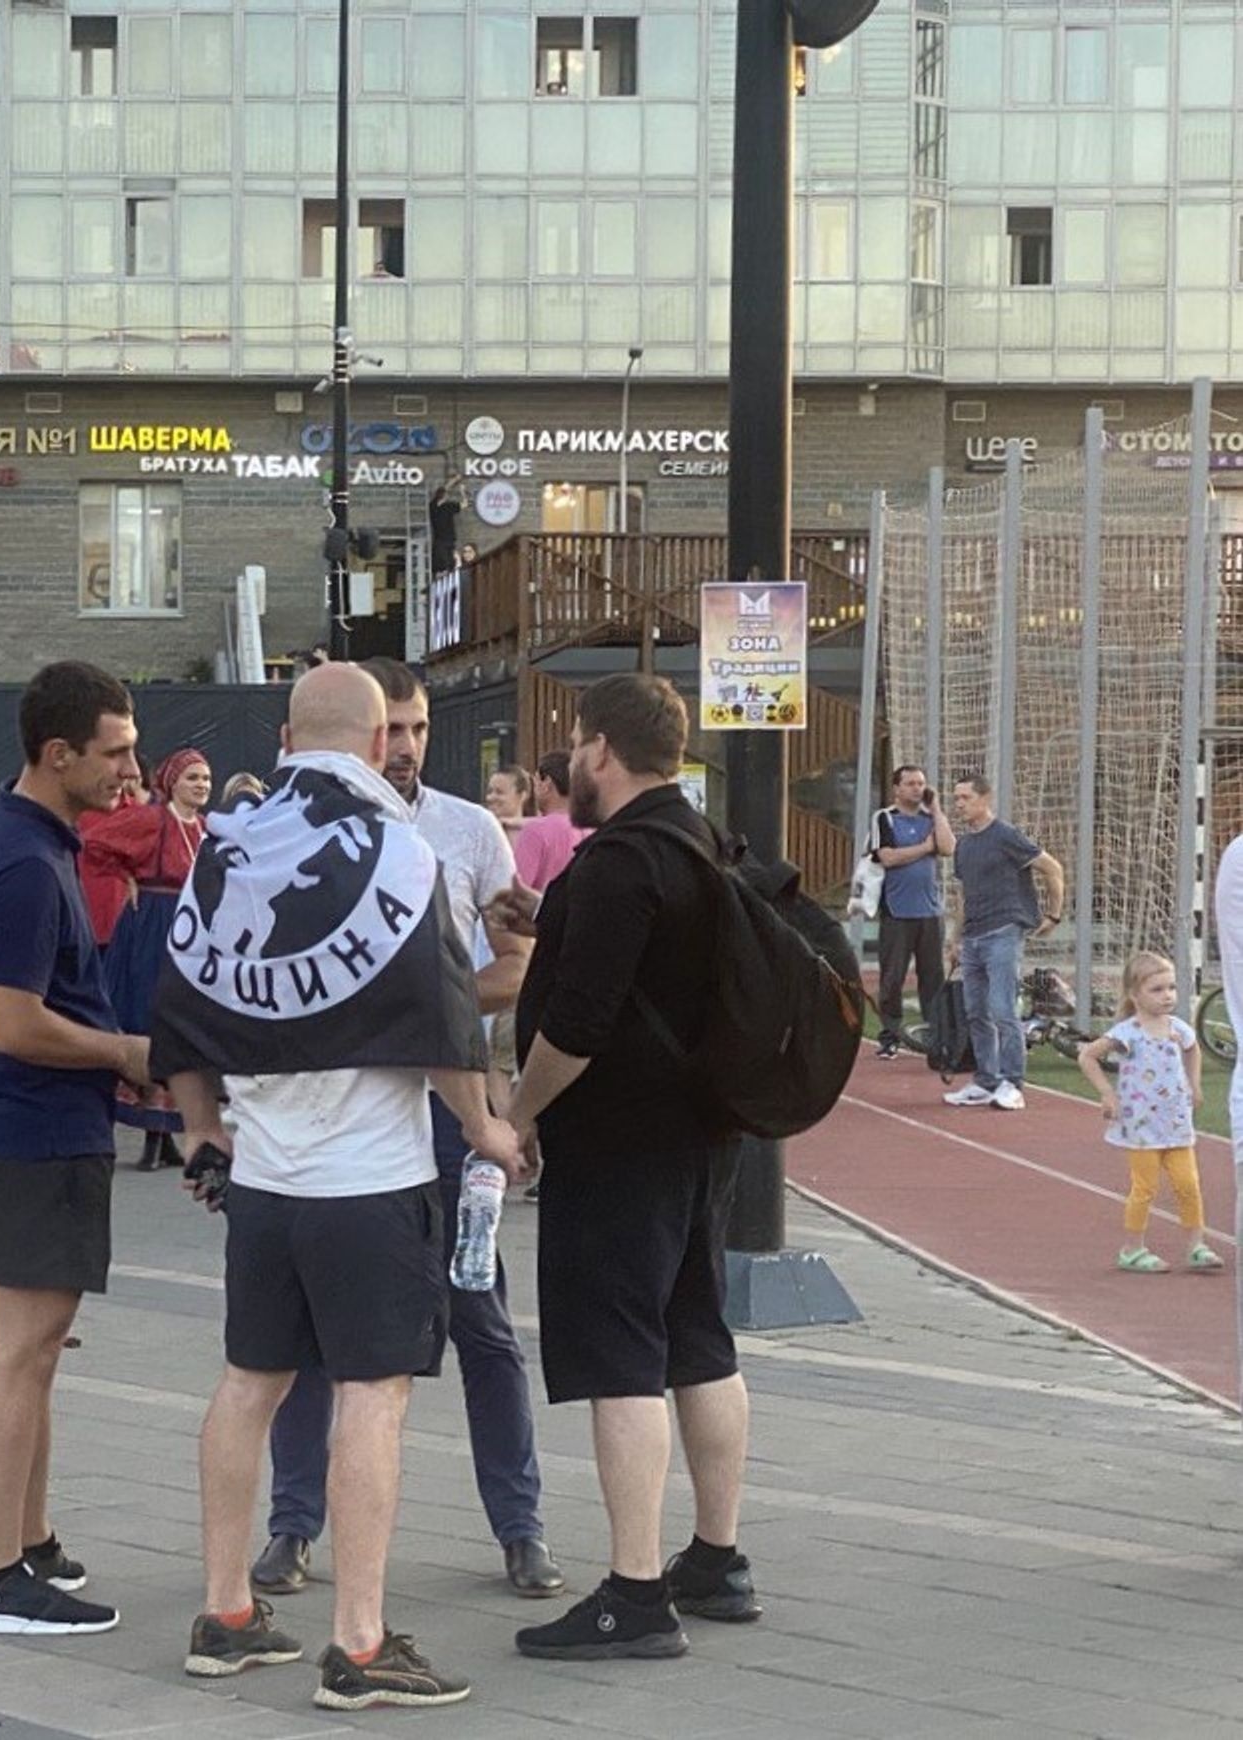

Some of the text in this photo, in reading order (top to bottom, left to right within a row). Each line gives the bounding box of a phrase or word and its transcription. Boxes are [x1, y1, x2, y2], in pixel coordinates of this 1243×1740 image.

[26, 427, 77, 454] №1
[90, 426, 231, 452] ШАВЕРМА
[140, 454, 321, 478] БРАТУХА ТАБАК
[351, 459, 424, 486] Avito
[464, 458, 533, 476] КОФЕ
[729, 635, 782, 652] ЗОНА
[170, 886, 414, 1013] ОБЩИНА
